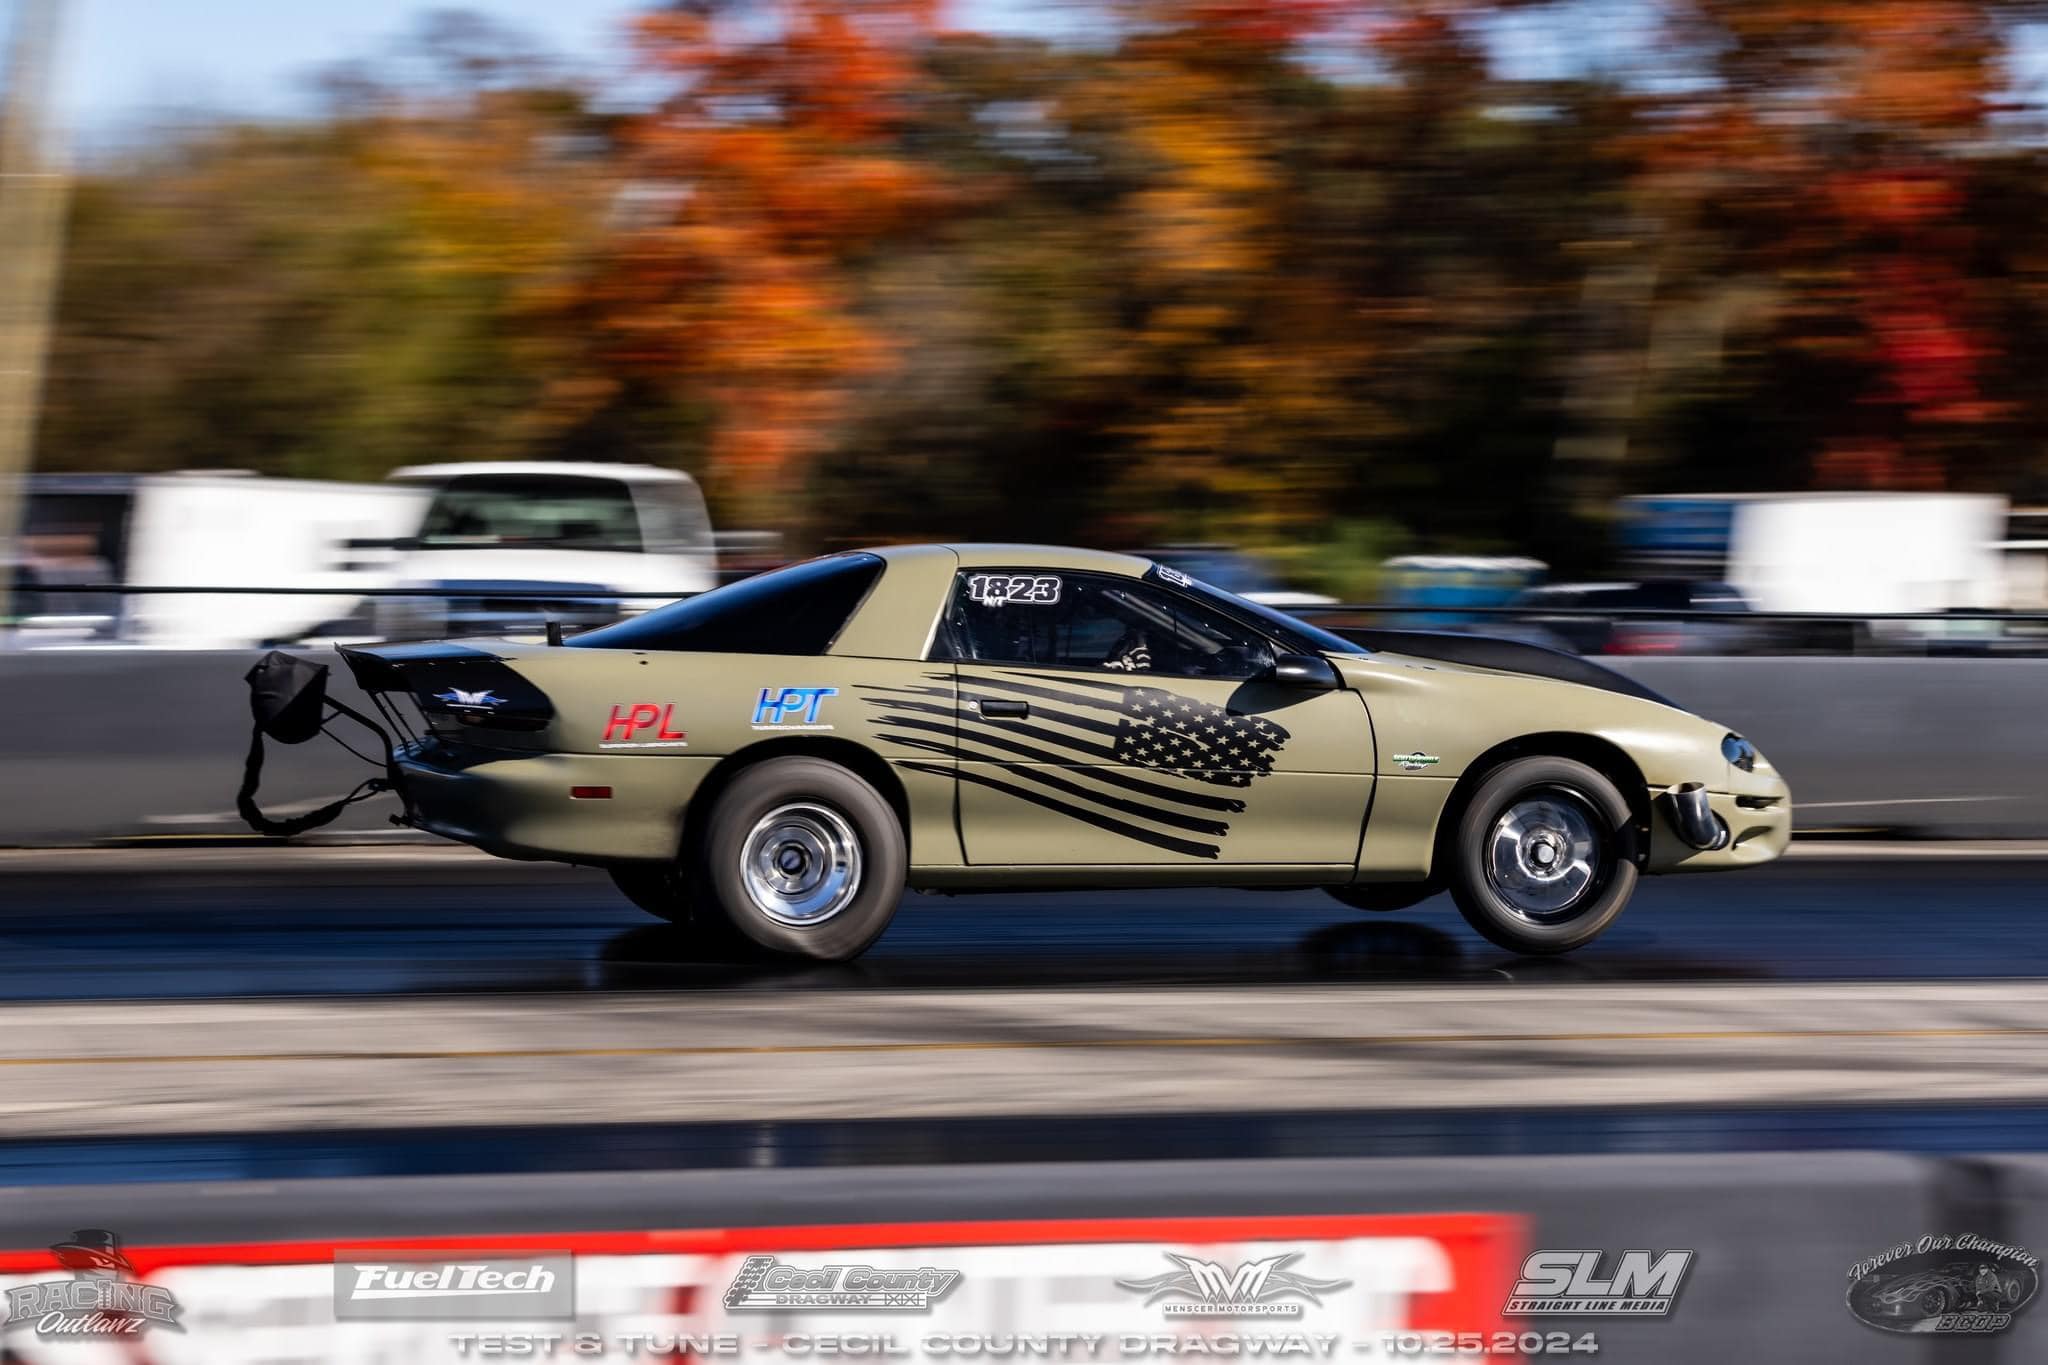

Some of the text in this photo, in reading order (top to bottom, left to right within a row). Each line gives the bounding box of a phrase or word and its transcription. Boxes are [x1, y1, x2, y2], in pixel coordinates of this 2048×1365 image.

[969, 575, 1061, 603] 1823
[602, 702, 688, 741] HPL
[752, 688, 839, 724] HPT
